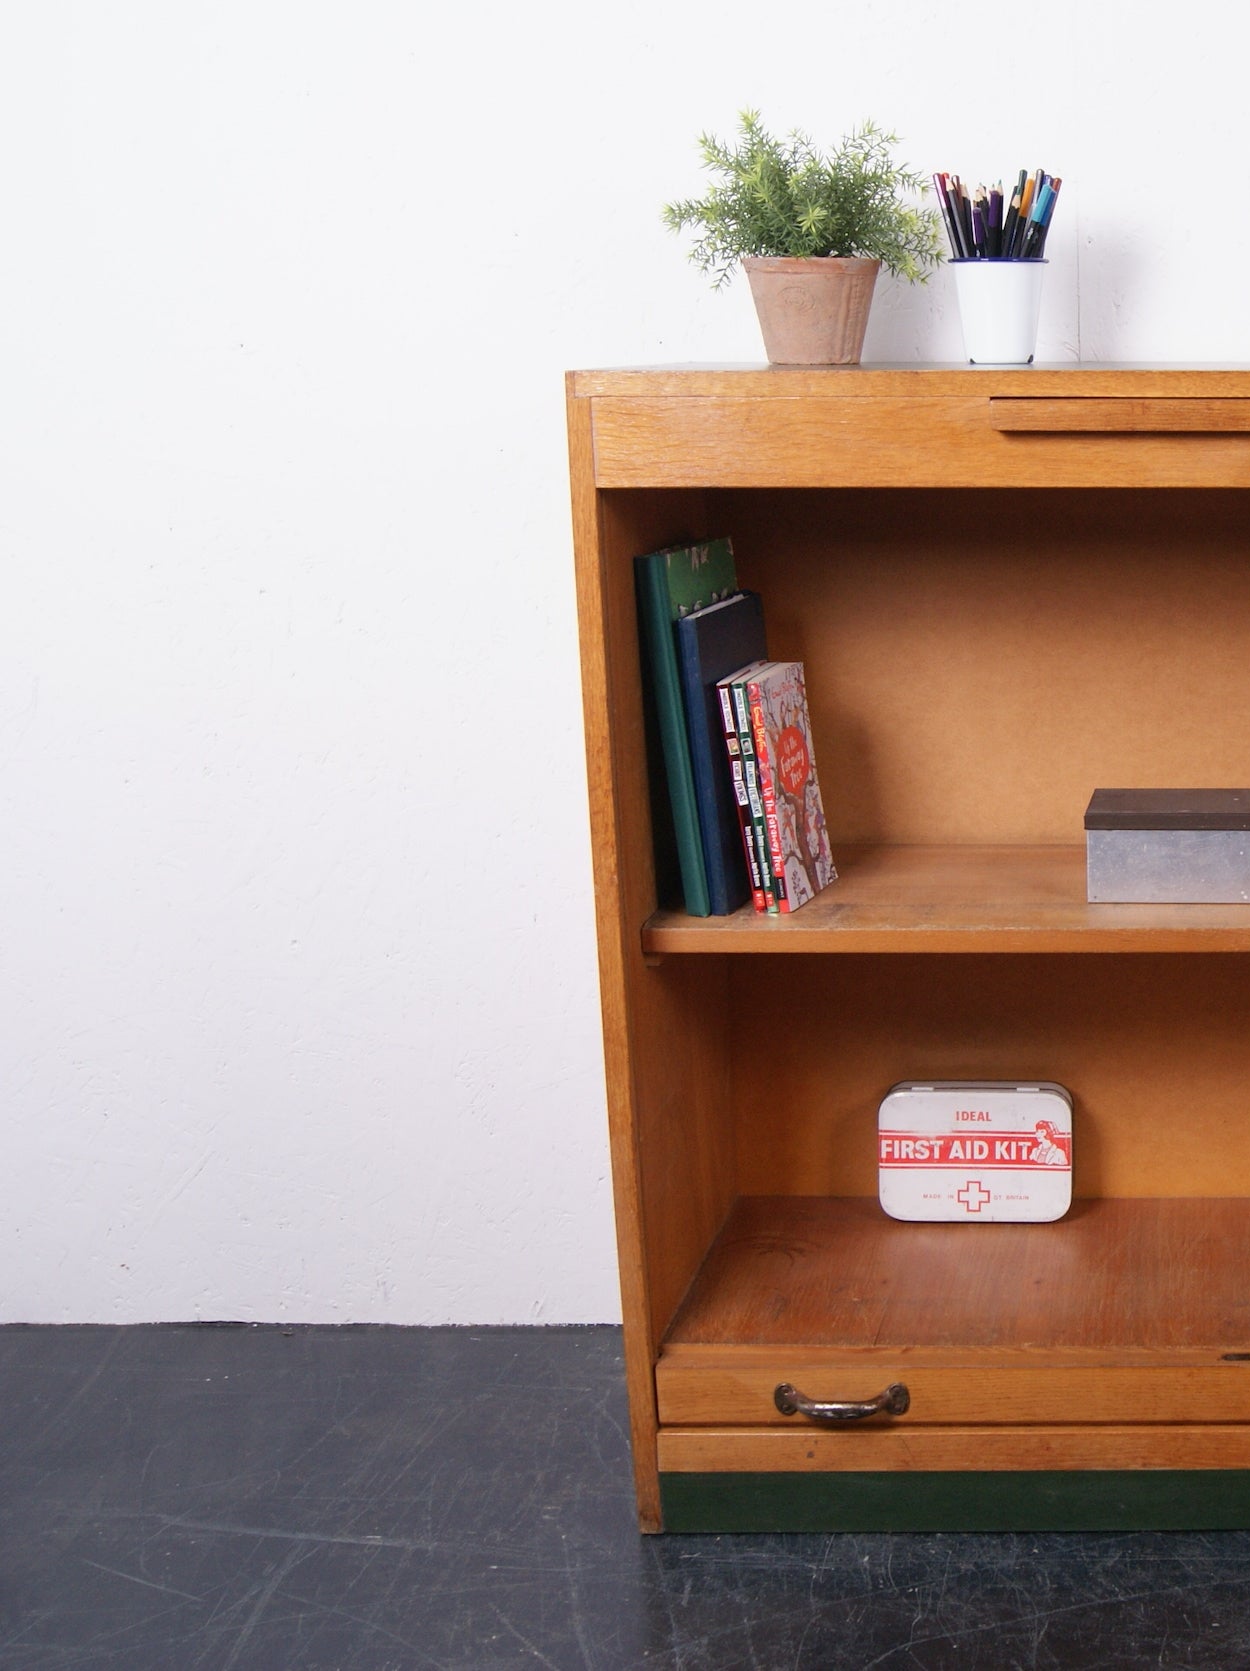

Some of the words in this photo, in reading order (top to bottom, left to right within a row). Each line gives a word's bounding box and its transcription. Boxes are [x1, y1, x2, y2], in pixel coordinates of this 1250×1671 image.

[766, 813, 781, 853] Faraway
[772, 855, 783, 873] Tree
[956, 1111, 992, 1122] IDEAL
[881, 1140, 944, 1160] FIRST
[949, 1140, 989, 1160] AID
[995, 1141, 1032, 1161] KIT
